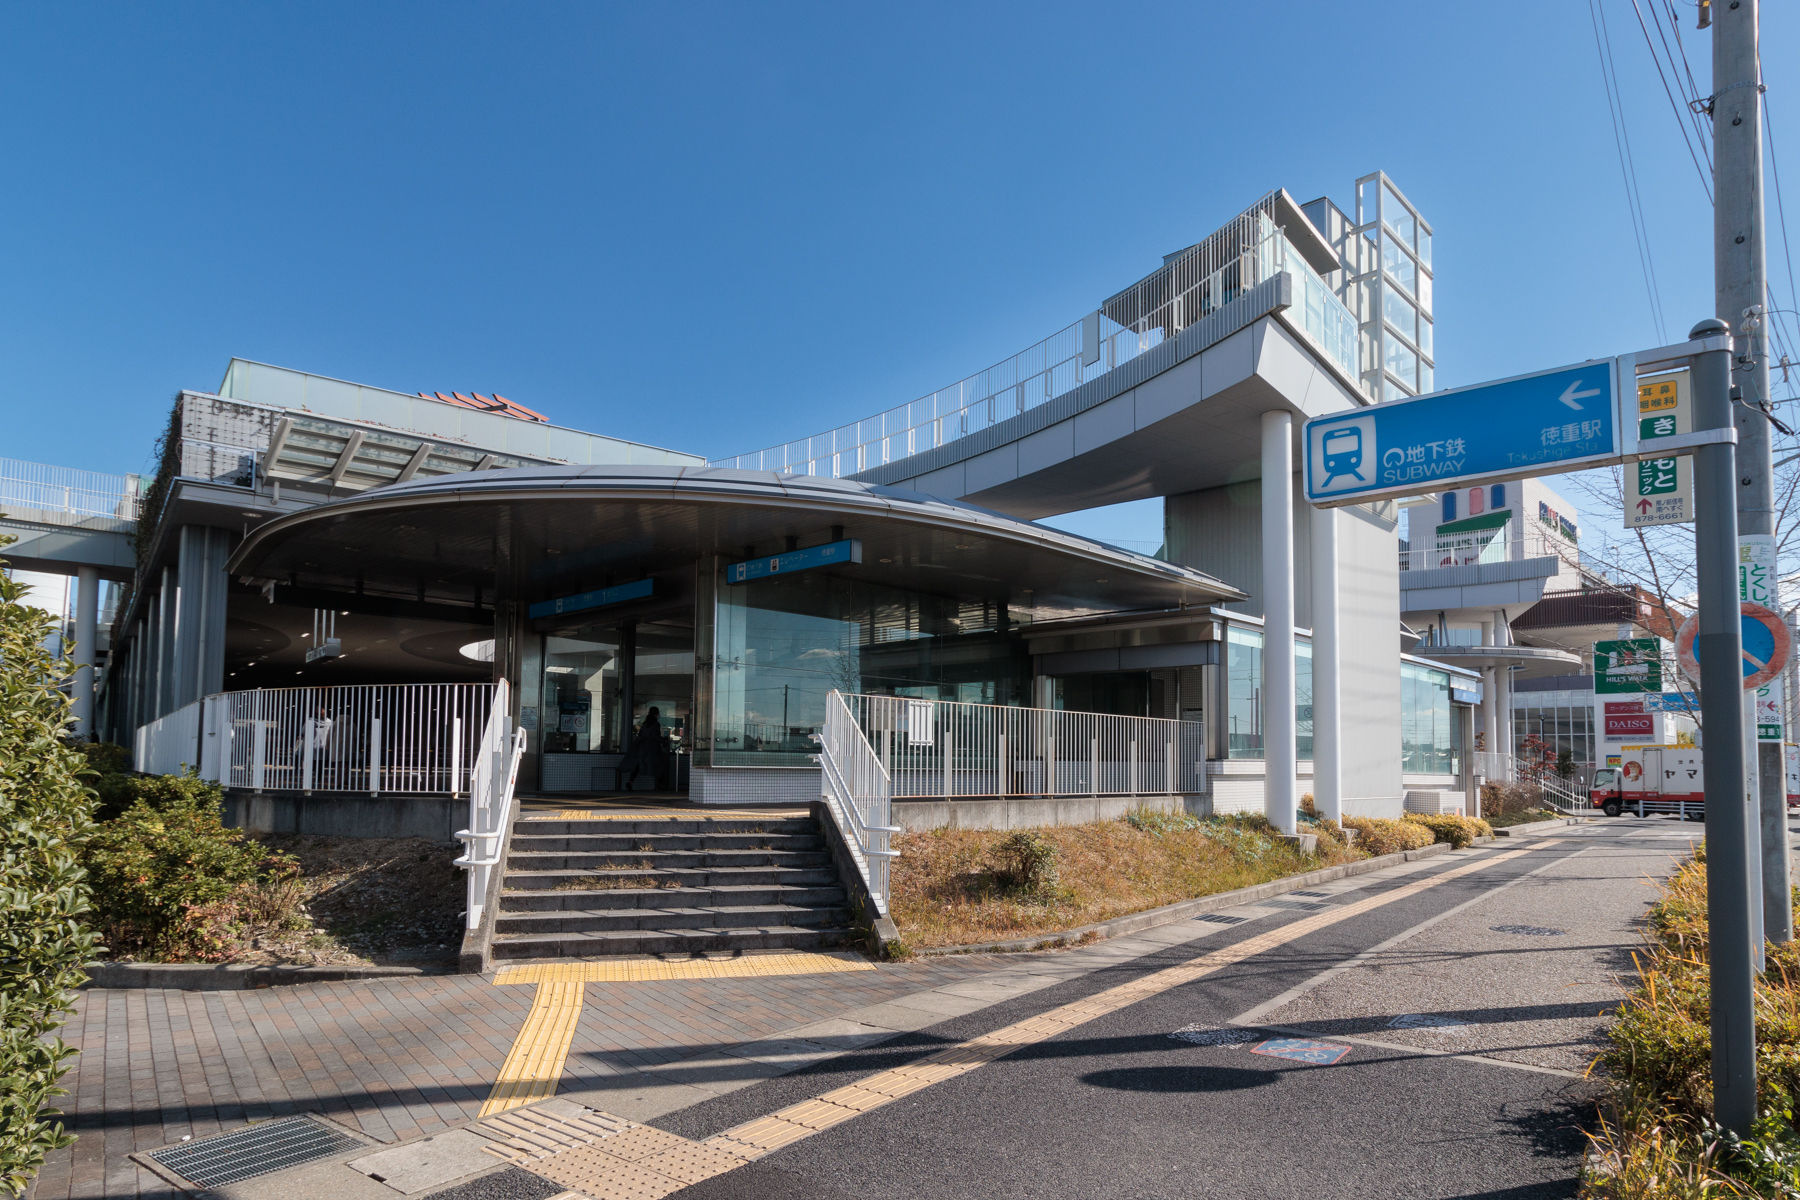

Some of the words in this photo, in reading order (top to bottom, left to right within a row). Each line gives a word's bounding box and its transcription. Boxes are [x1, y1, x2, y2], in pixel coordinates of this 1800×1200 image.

[1540, 419, 1602, 446] 徳重駅
[1406, 438, 1466, 463] 地下鉄
[1506, 446, 1571, 464] Tokushige
[1383, 458, 1466, 484] SUBWAY
[1634, 512, 1683, 523] 878-6661
[1609, 720, 1650, 728] DAISO
